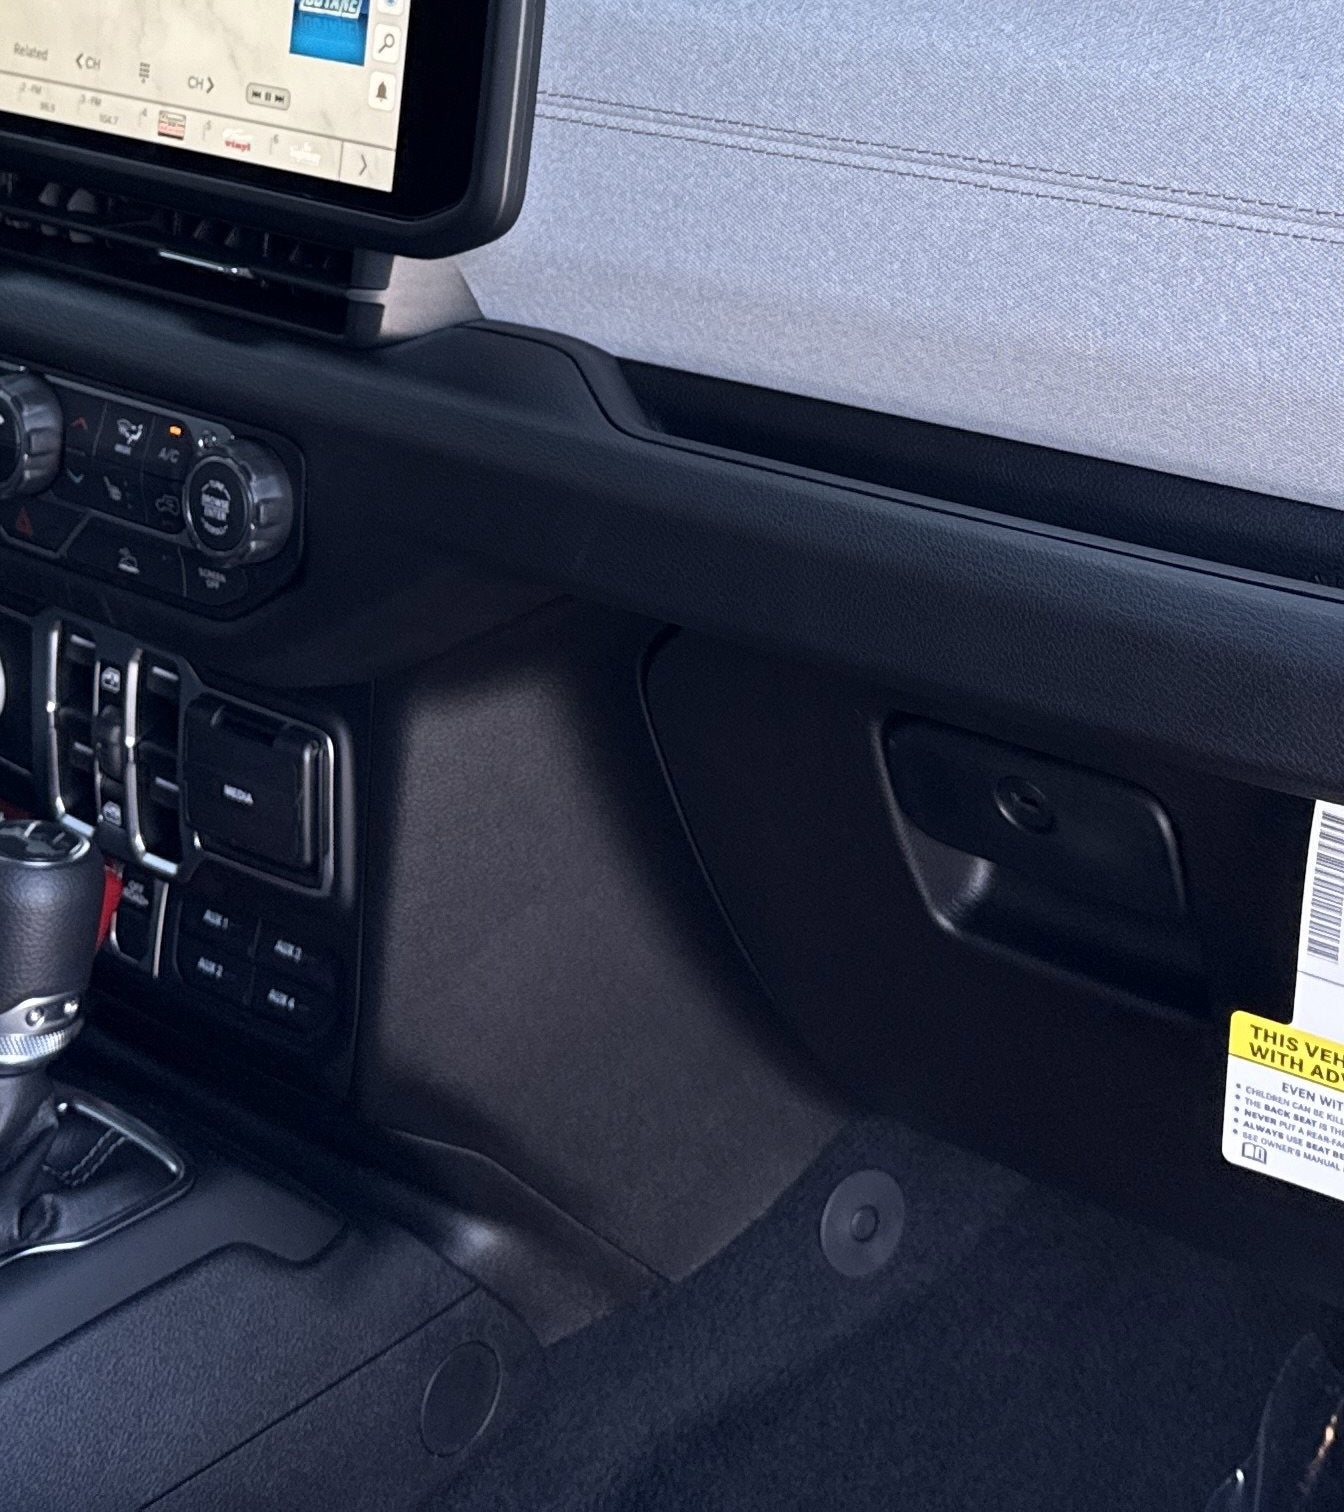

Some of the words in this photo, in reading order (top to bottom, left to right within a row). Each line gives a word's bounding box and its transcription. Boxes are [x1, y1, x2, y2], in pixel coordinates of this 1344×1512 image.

[14, 42, 49, 61] Related
[85, 58, 101, 71] CH
[187, 76, 204, 91] CH
[158, 447, 180, 464] A/C
[224, 784, 254, 805] MEDIA
[1249, 1022, 1298, 1053] THIS
[1248, 1040, 1303, 1073] WITH
[1245, 1084, 1289, 1107] CHILDREN
[1291, 1100, 1310, 1114] CAN
[1313, 1107, 1323, 1118] BE
[1281, 1081, 1315, 1102] EVEN
[1244, 1107, 1276, 1126] NEVER
[1279, 1119, 1295, 1132] PUT
[1298, 1126, 1304, 1135] A
[1245, 1096, 1260, 1109] THE
[1264, 1102, 1290, 1118] BACK
[1293, 1113, 1316, 1127] SEAT
[1319, 1122, 1327, 1131] IS
[1242, 1130, 1258, 1143] SEE
[1303, 1151, 1340, 1171] MANUAL
[1243, 1119, 1283, 1140] ALWAYS
[1286, 1133, 1303, 1147] USE
[1305, 1140, 1329, 1155] SEAT
